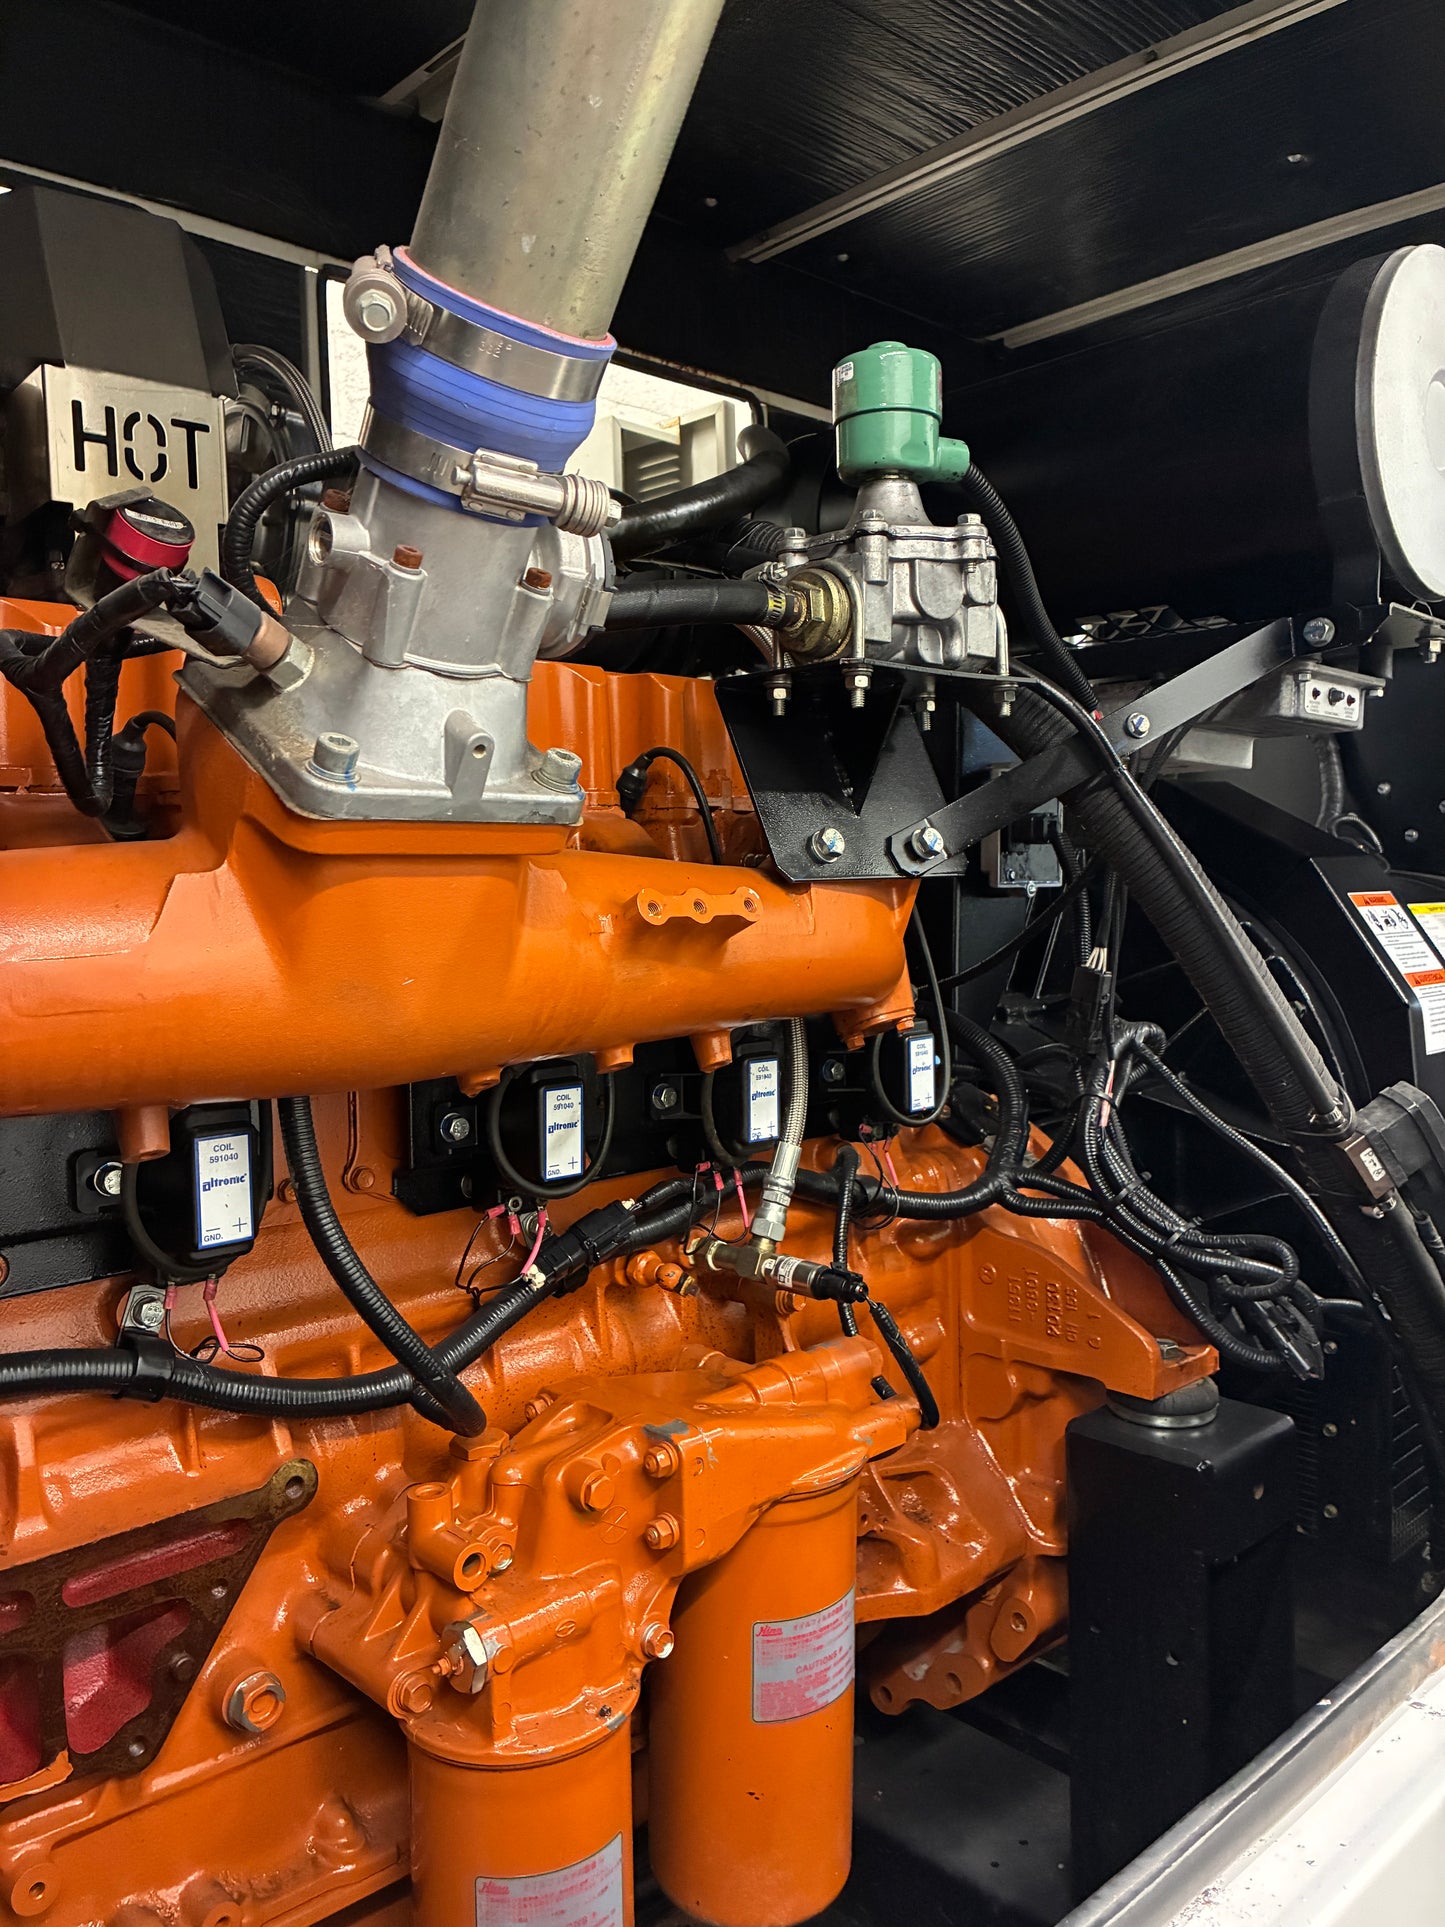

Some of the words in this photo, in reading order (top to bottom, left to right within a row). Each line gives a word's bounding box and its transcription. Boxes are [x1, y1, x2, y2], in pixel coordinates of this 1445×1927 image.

[71, 399, 210, 490] HOT
[553, 1102, 574, 1111] 591040
[213, 1143, 234, 1153] COIL
[209, 1152, 238, 1164] 591040
[203, 1233, 223, 1242] GND.
